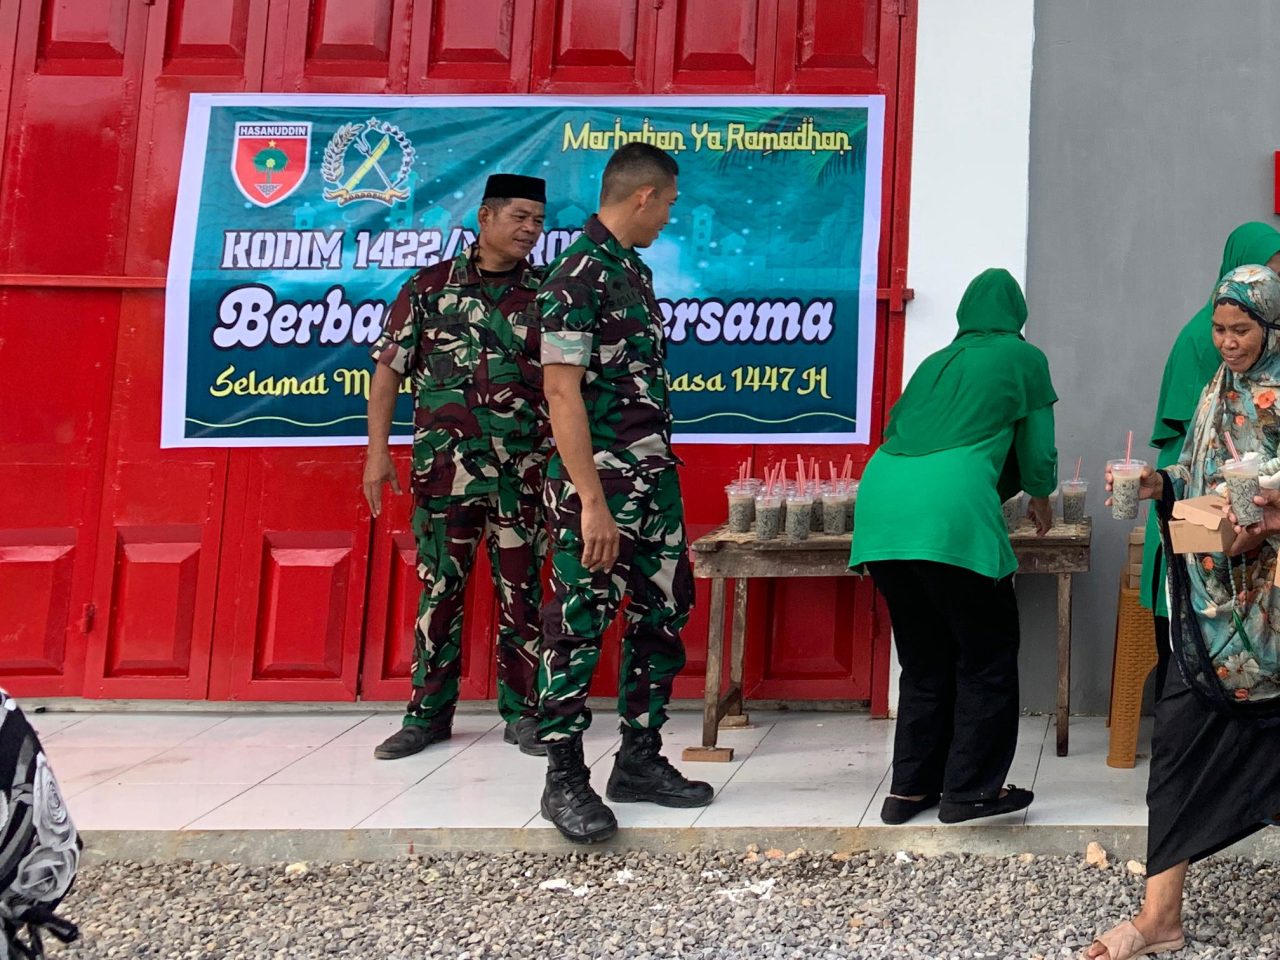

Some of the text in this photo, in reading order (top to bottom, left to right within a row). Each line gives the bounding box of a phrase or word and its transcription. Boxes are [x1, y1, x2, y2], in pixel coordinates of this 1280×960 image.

[240, 125, 307, 137] HASANUDDIN
[691, 122, 724, 153] Ya
[726, 117, 853, 156] Ramadhan
[220, 231, 343, 269] KODIM
[657, 300, 834, 343] ersama
[210, 365, 330, 398] Selamat
[731, 366, 796, 393] 1447
